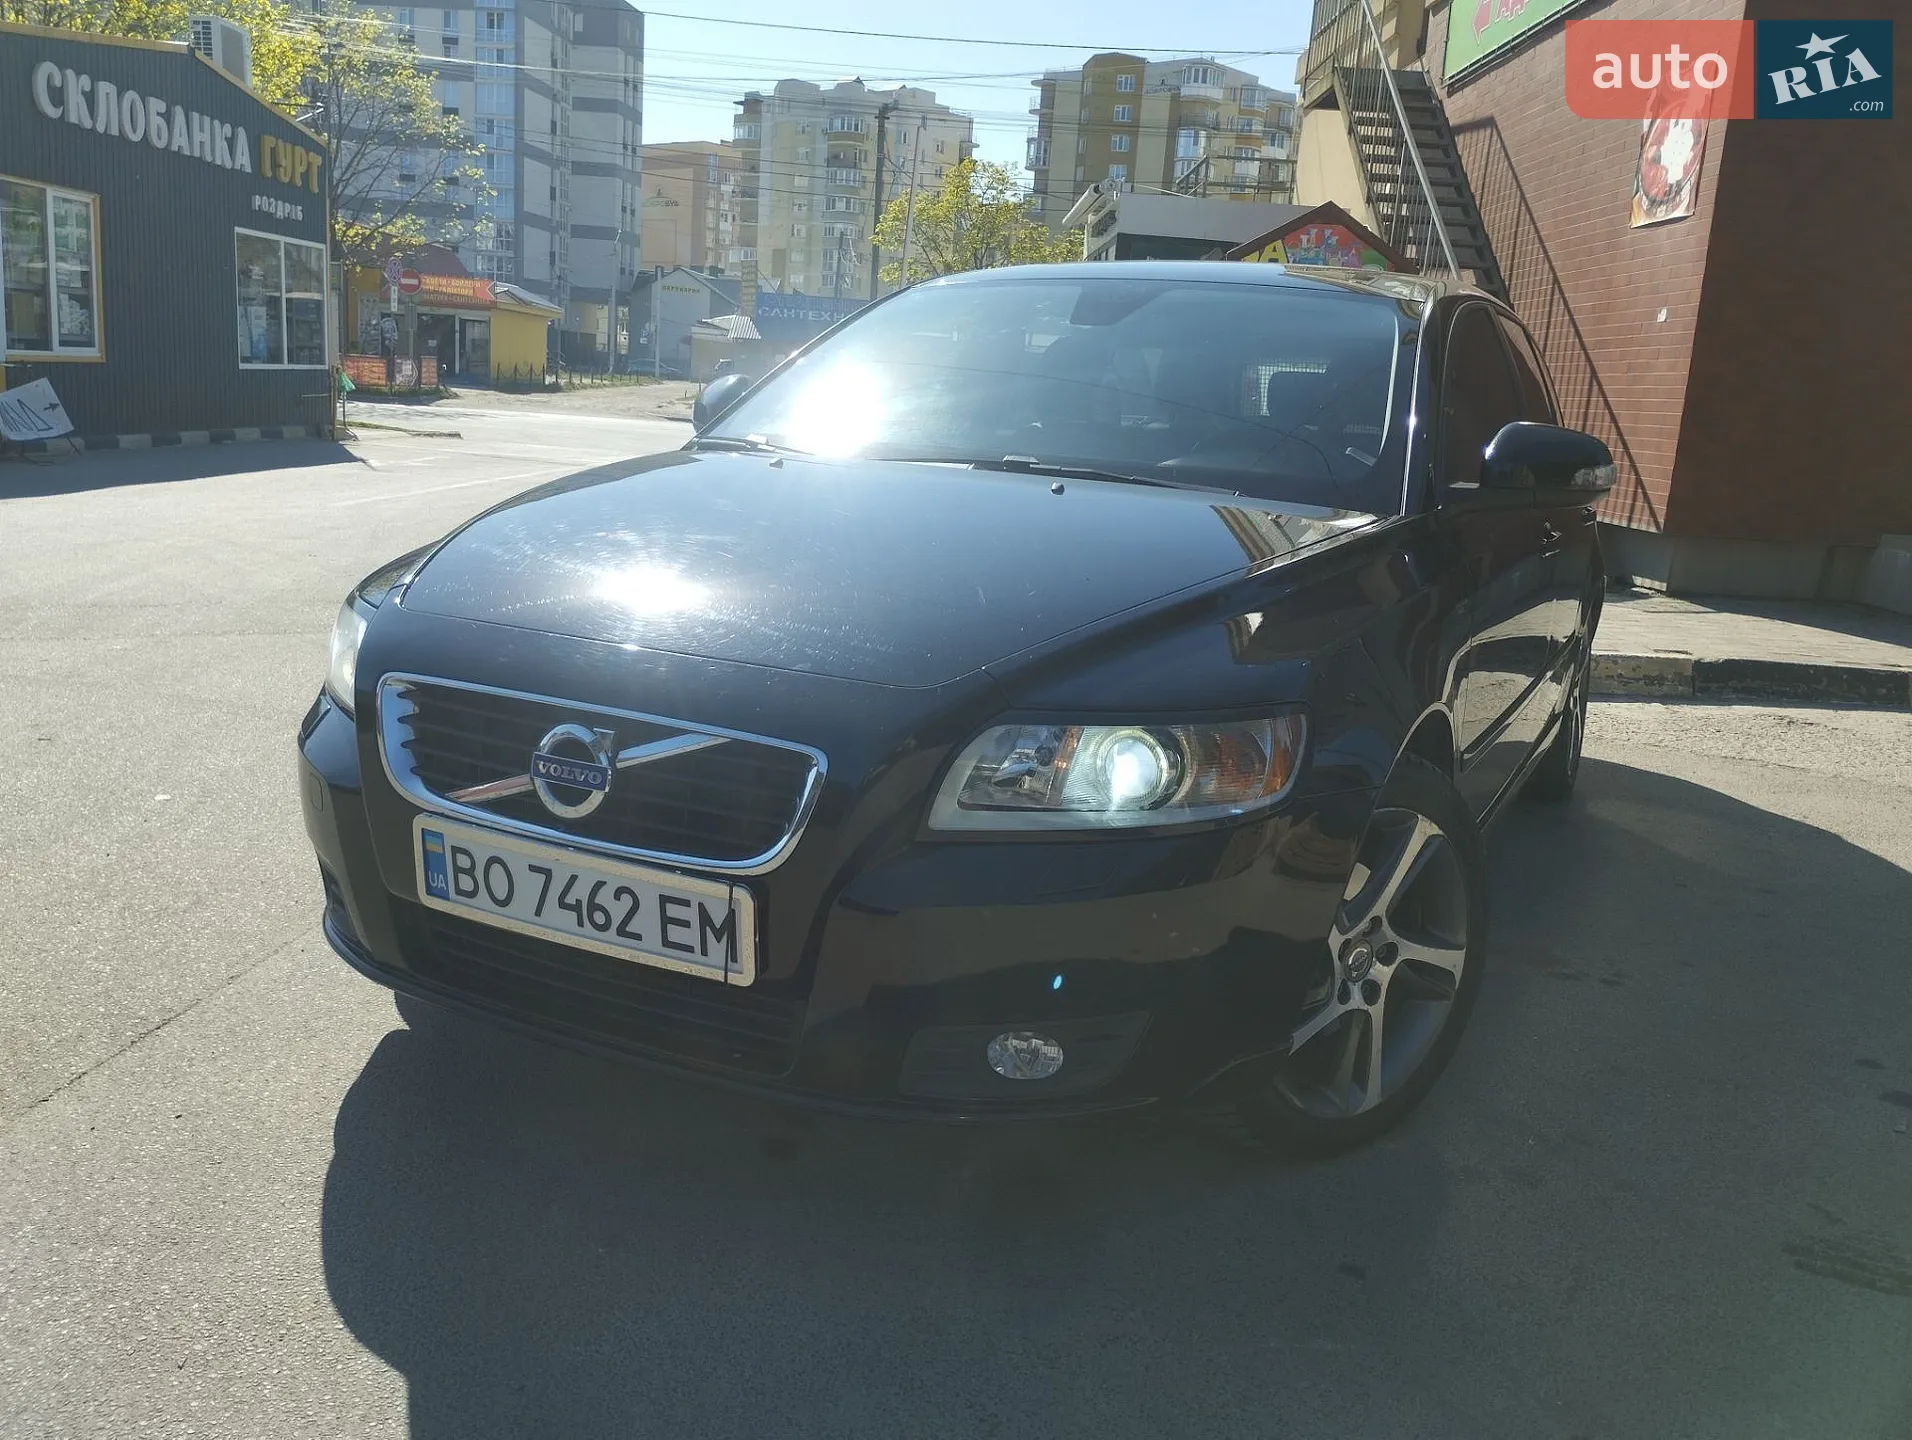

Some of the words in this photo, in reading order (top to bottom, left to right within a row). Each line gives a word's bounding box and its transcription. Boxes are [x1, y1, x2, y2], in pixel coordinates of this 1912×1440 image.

[32, 61, 252, 174] СКЛОБАНКА
[260, 134, 323, 194] ГУРТ
[252, 194, 304, 221] РОЗДРІБ
[535, 759, 603, 785] VOLVO
[428, 870, 447, 891] UA
[450, 845, 515, 908] BO
[528, 863, 643, 942] 7462
[658, 893, 738, 964] EM
